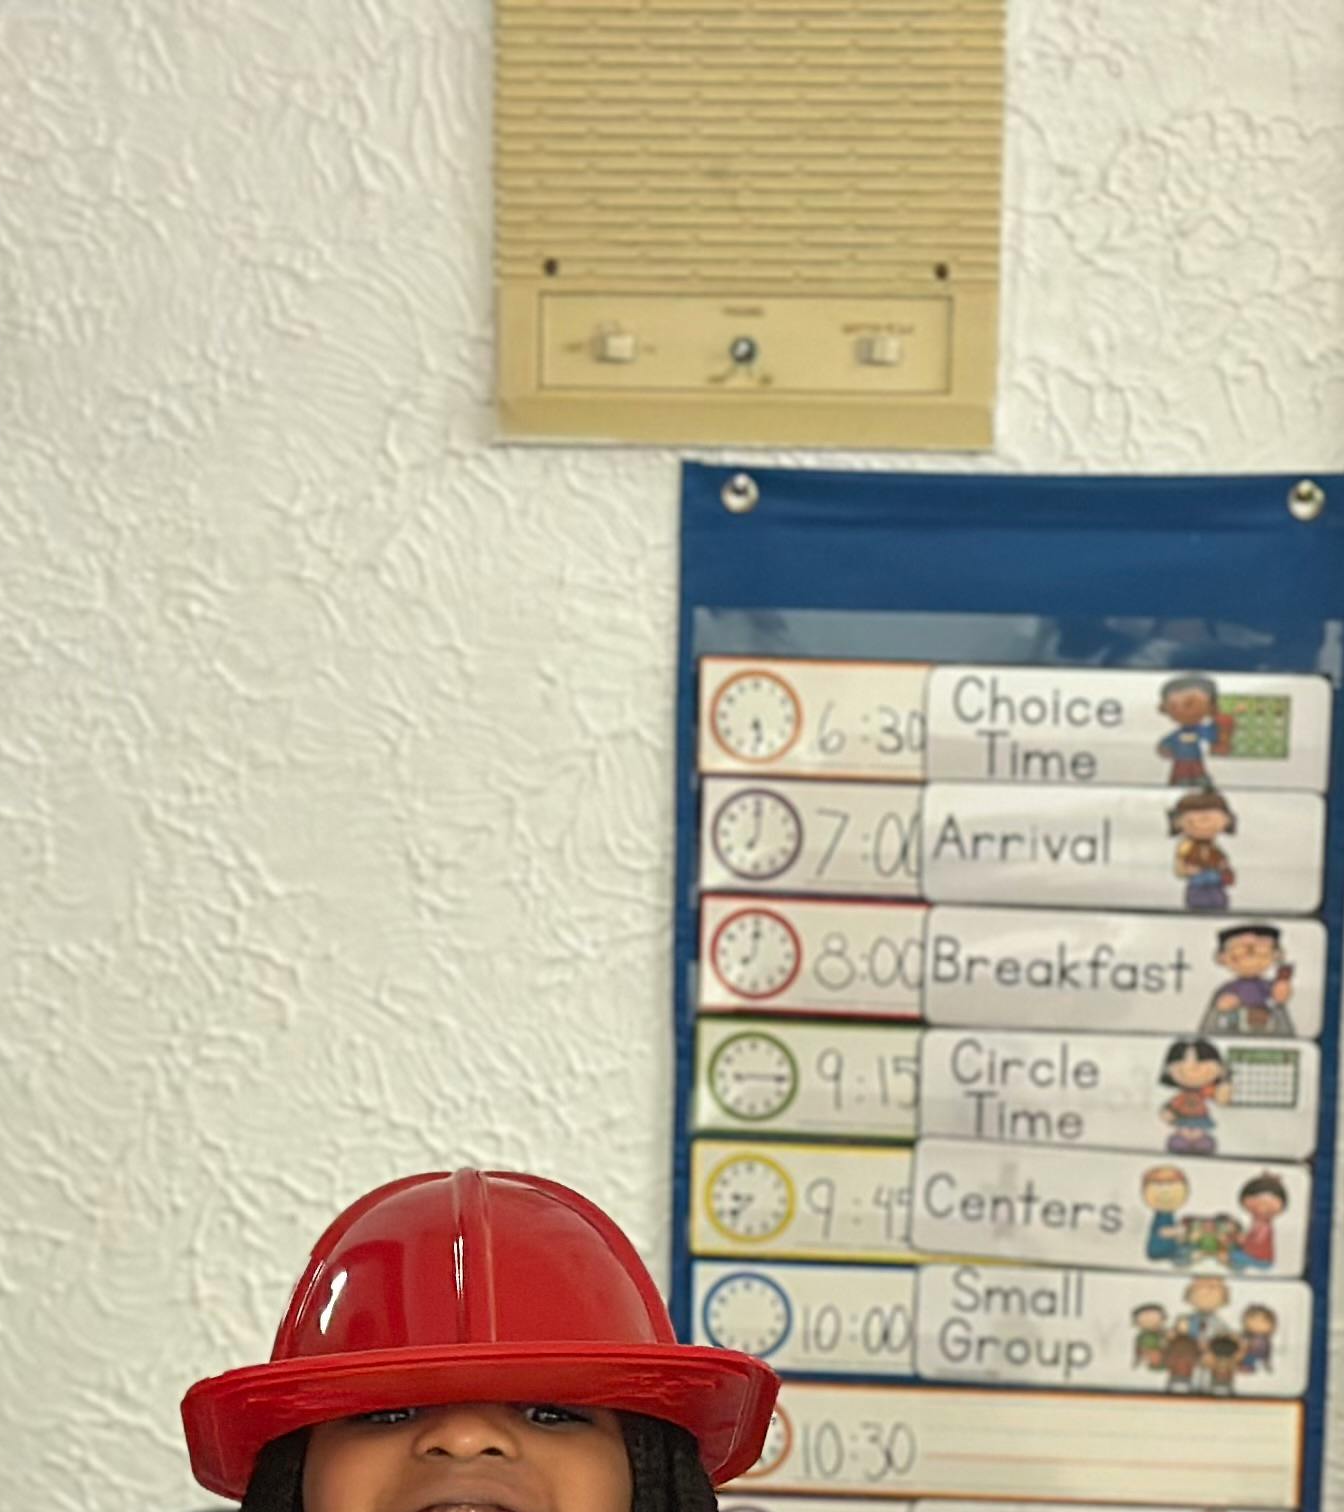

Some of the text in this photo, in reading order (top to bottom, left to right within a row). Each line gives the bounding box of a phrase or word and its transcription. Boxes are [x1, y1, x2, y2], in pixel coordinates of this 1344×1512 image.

[817, 699, 926, 757] 6:30
[952, 675, 1124, 728] Choice
[976, 729, 1098, 782] Time
[932, 816, 1112, 867] Arrival
[812, 931, 924, 992] 8:00
[931, 934, 1192, 996] Breakfast
[949, 1037, 1101, 1090] Circle
[963, 1090, 1085, 1142] Time
[923, 1171, 1124, 1236] Centers
[951, 1266, 1086, 1316] Small
[801, 1303, 914, 1356] 10:00
[938, 1318, 1094, 1380] Group
[799, 1419, 917, 1481] 10:30
